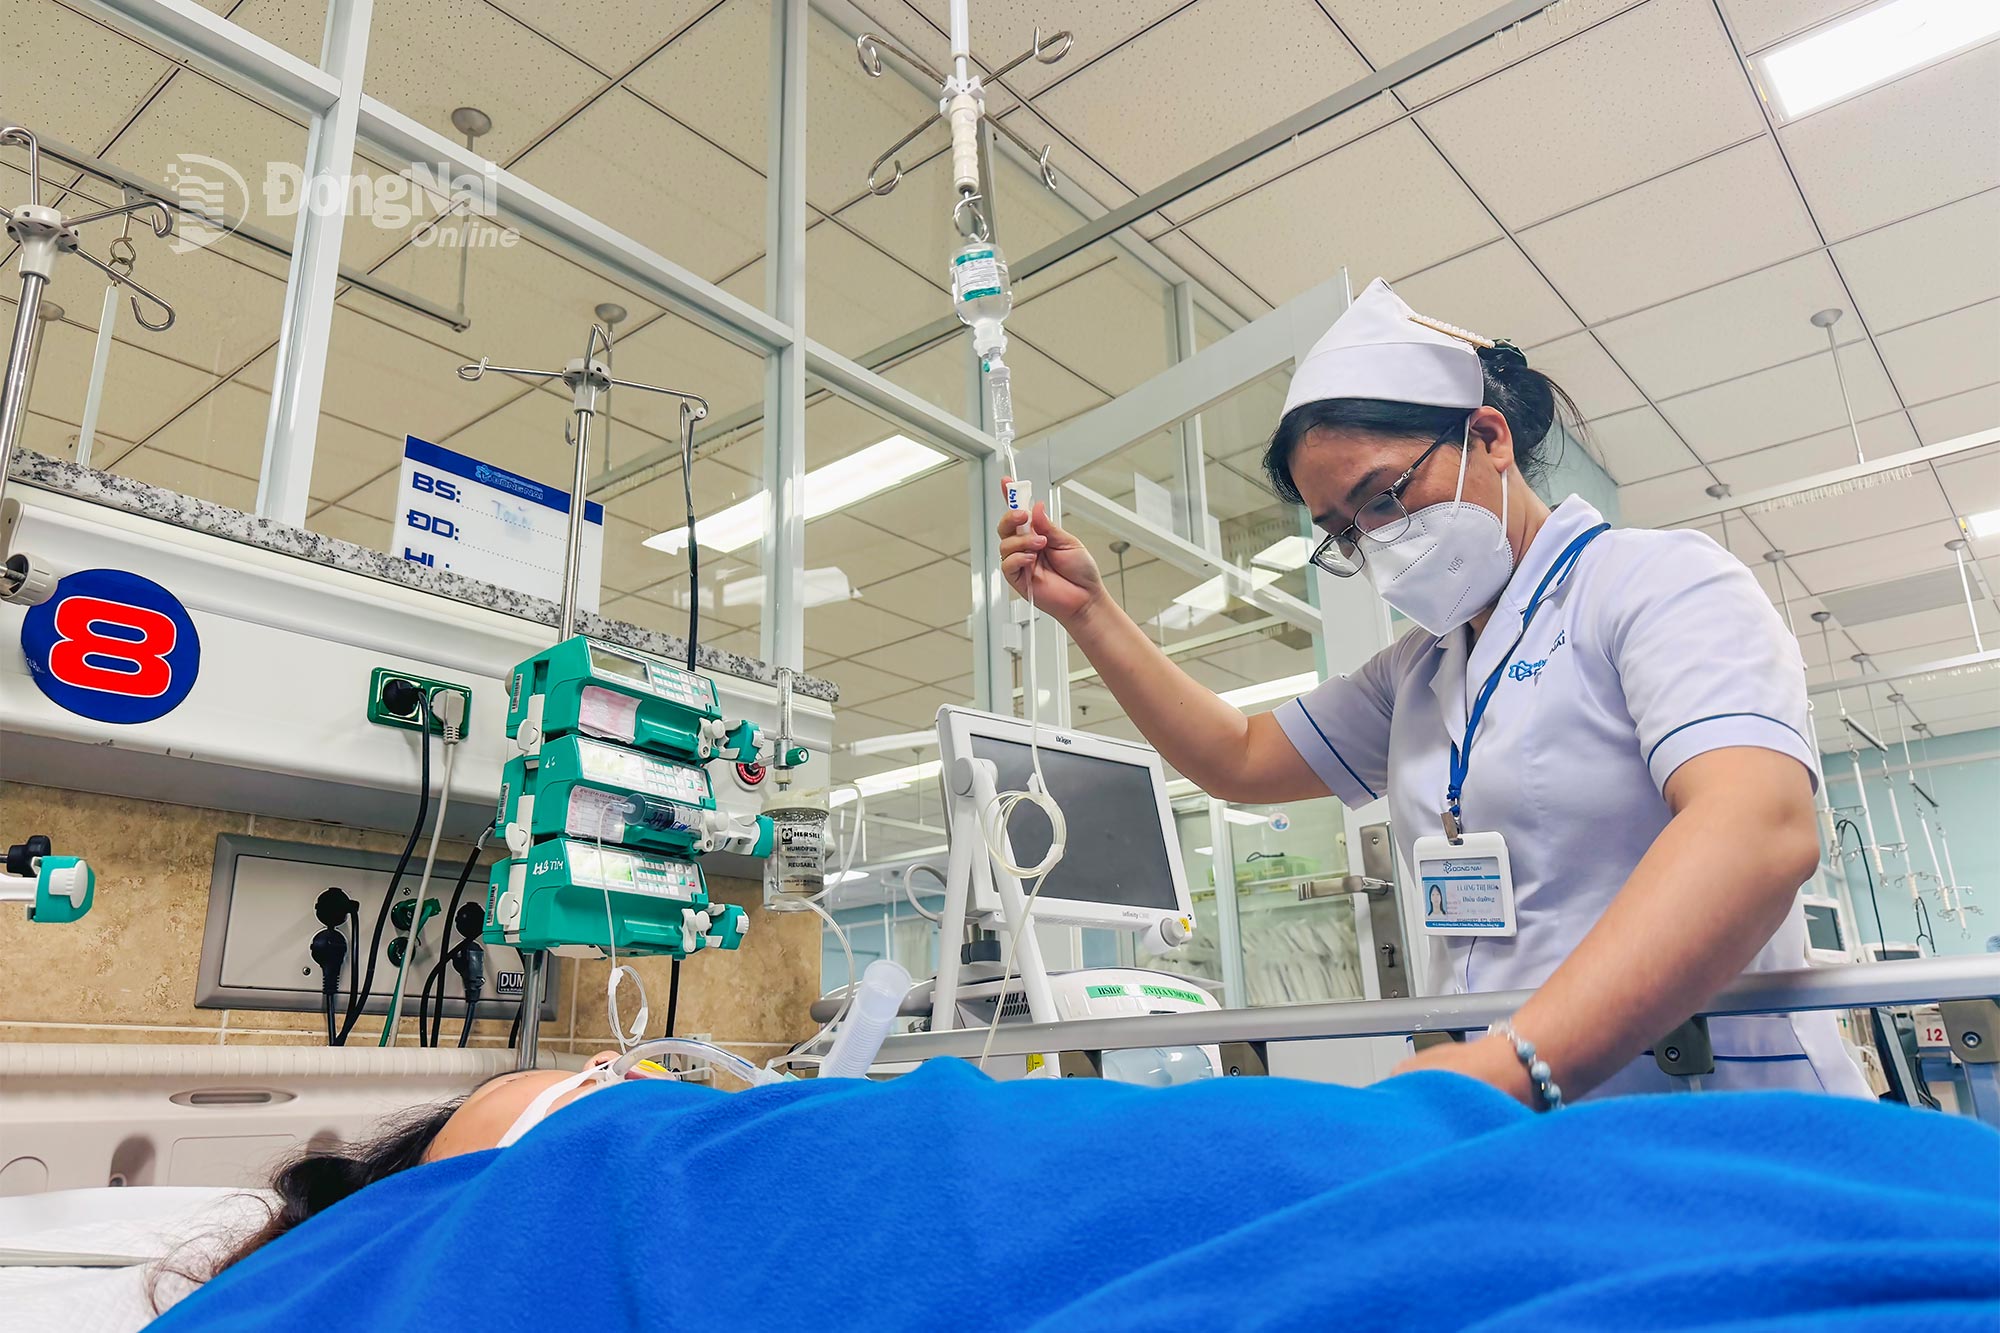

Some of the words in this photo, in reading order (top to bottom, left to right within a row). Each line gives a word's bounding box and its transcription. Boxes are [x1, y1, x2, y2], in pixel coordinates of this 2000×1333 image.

[412, 471, 461, 503] BS:
[406, 508, 460, 540] ĐD:
[1447, 556, 1464, 575] N95
[49, 596, 177, 698] 8
[1926, 1027, 1943, 1042] 12
